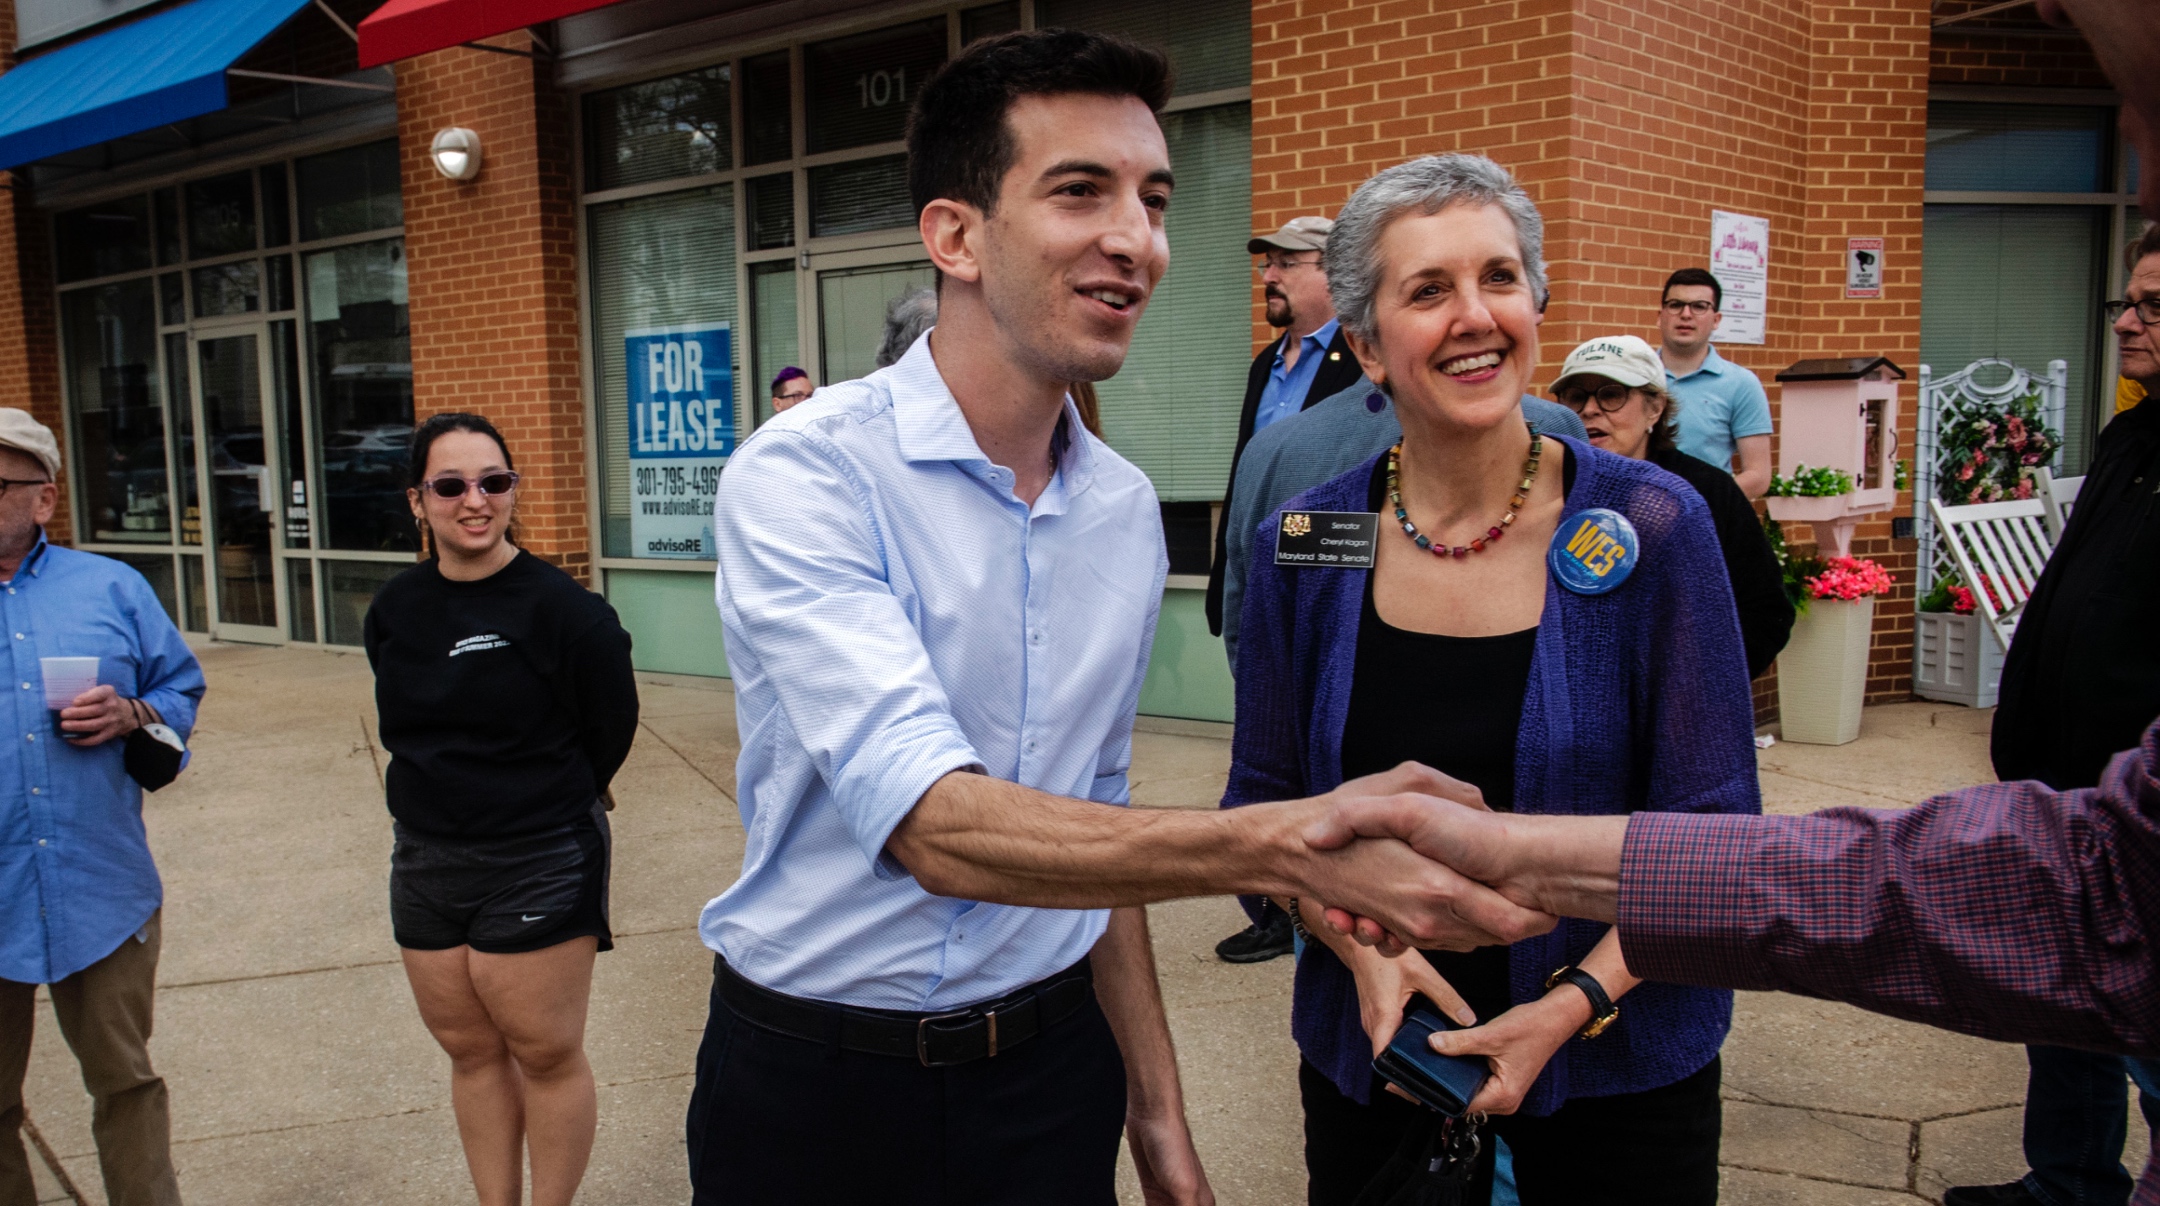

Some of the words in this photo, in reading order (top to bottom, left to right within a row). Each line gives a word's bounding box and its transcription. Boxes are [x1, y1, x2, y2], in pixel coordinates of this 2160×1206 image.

[856, 67, 906, 109] 101
[1576, 343, 1624, 360] TULANE
[649, 340, 704, 394] FOR
[636, 399, 724, 452] LEASE
[642, 498, 715, 515] www.advisoRE.co
[1331, 522, 1361, 530] Senator
[648, 538, 702, 552] advisoRE
[1320, 538, 1344, 547] Cheryl
[1344, 539, 1370, 547] Kagan
[1566, 519, 1626, 577] WES
[1278, 552, 1315, 561] Maryland
[1318, 553, 1339, 561] State
[1341, 554, 1370, 563] Senate
